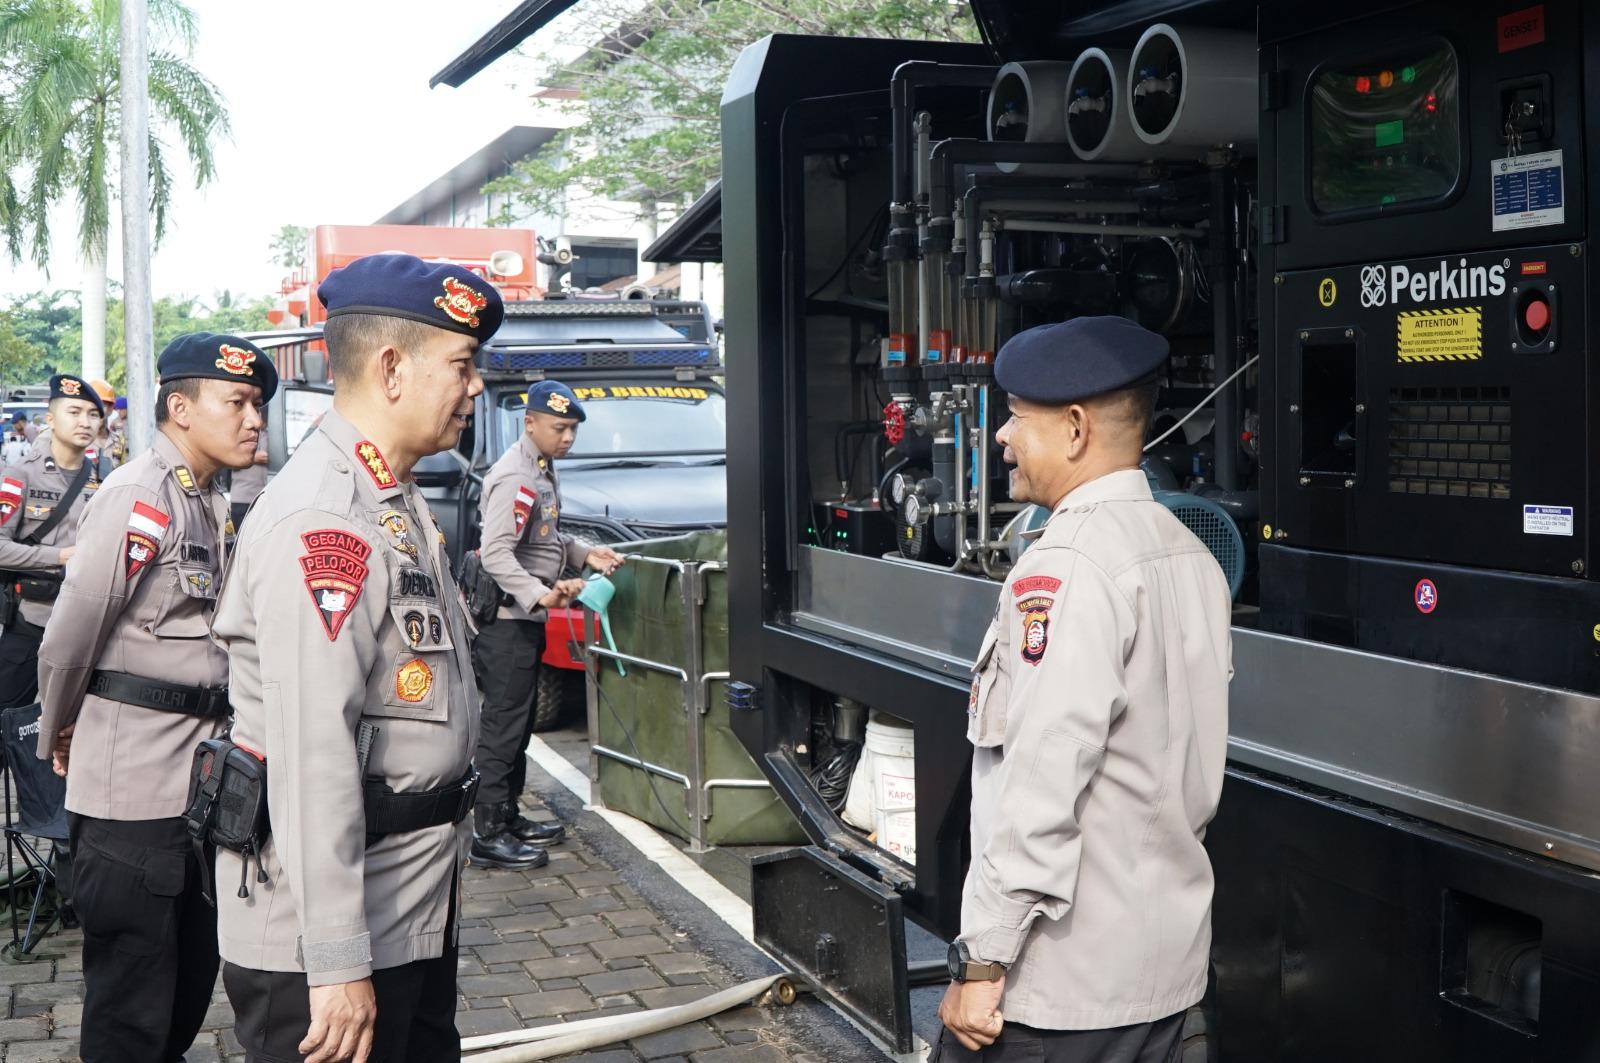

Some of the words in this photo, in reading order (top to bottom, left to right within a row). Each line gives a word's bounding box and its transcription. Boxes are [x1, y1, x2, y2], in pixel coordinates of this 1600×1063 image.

[1504, 20, 1537, 38] GENSET
[1391, 258, 1506, 303] Perkins
[1415, 318, 1458, 328] ATTENTION
[610, 386, 708, 400] BRIMOB
[30, 490, 62, 501] RICKY
[308, 534, 364, 557] GEGANA
[306, 556, 362, 580] PELOPOR
[888, 790, 914, 801] KAPO
